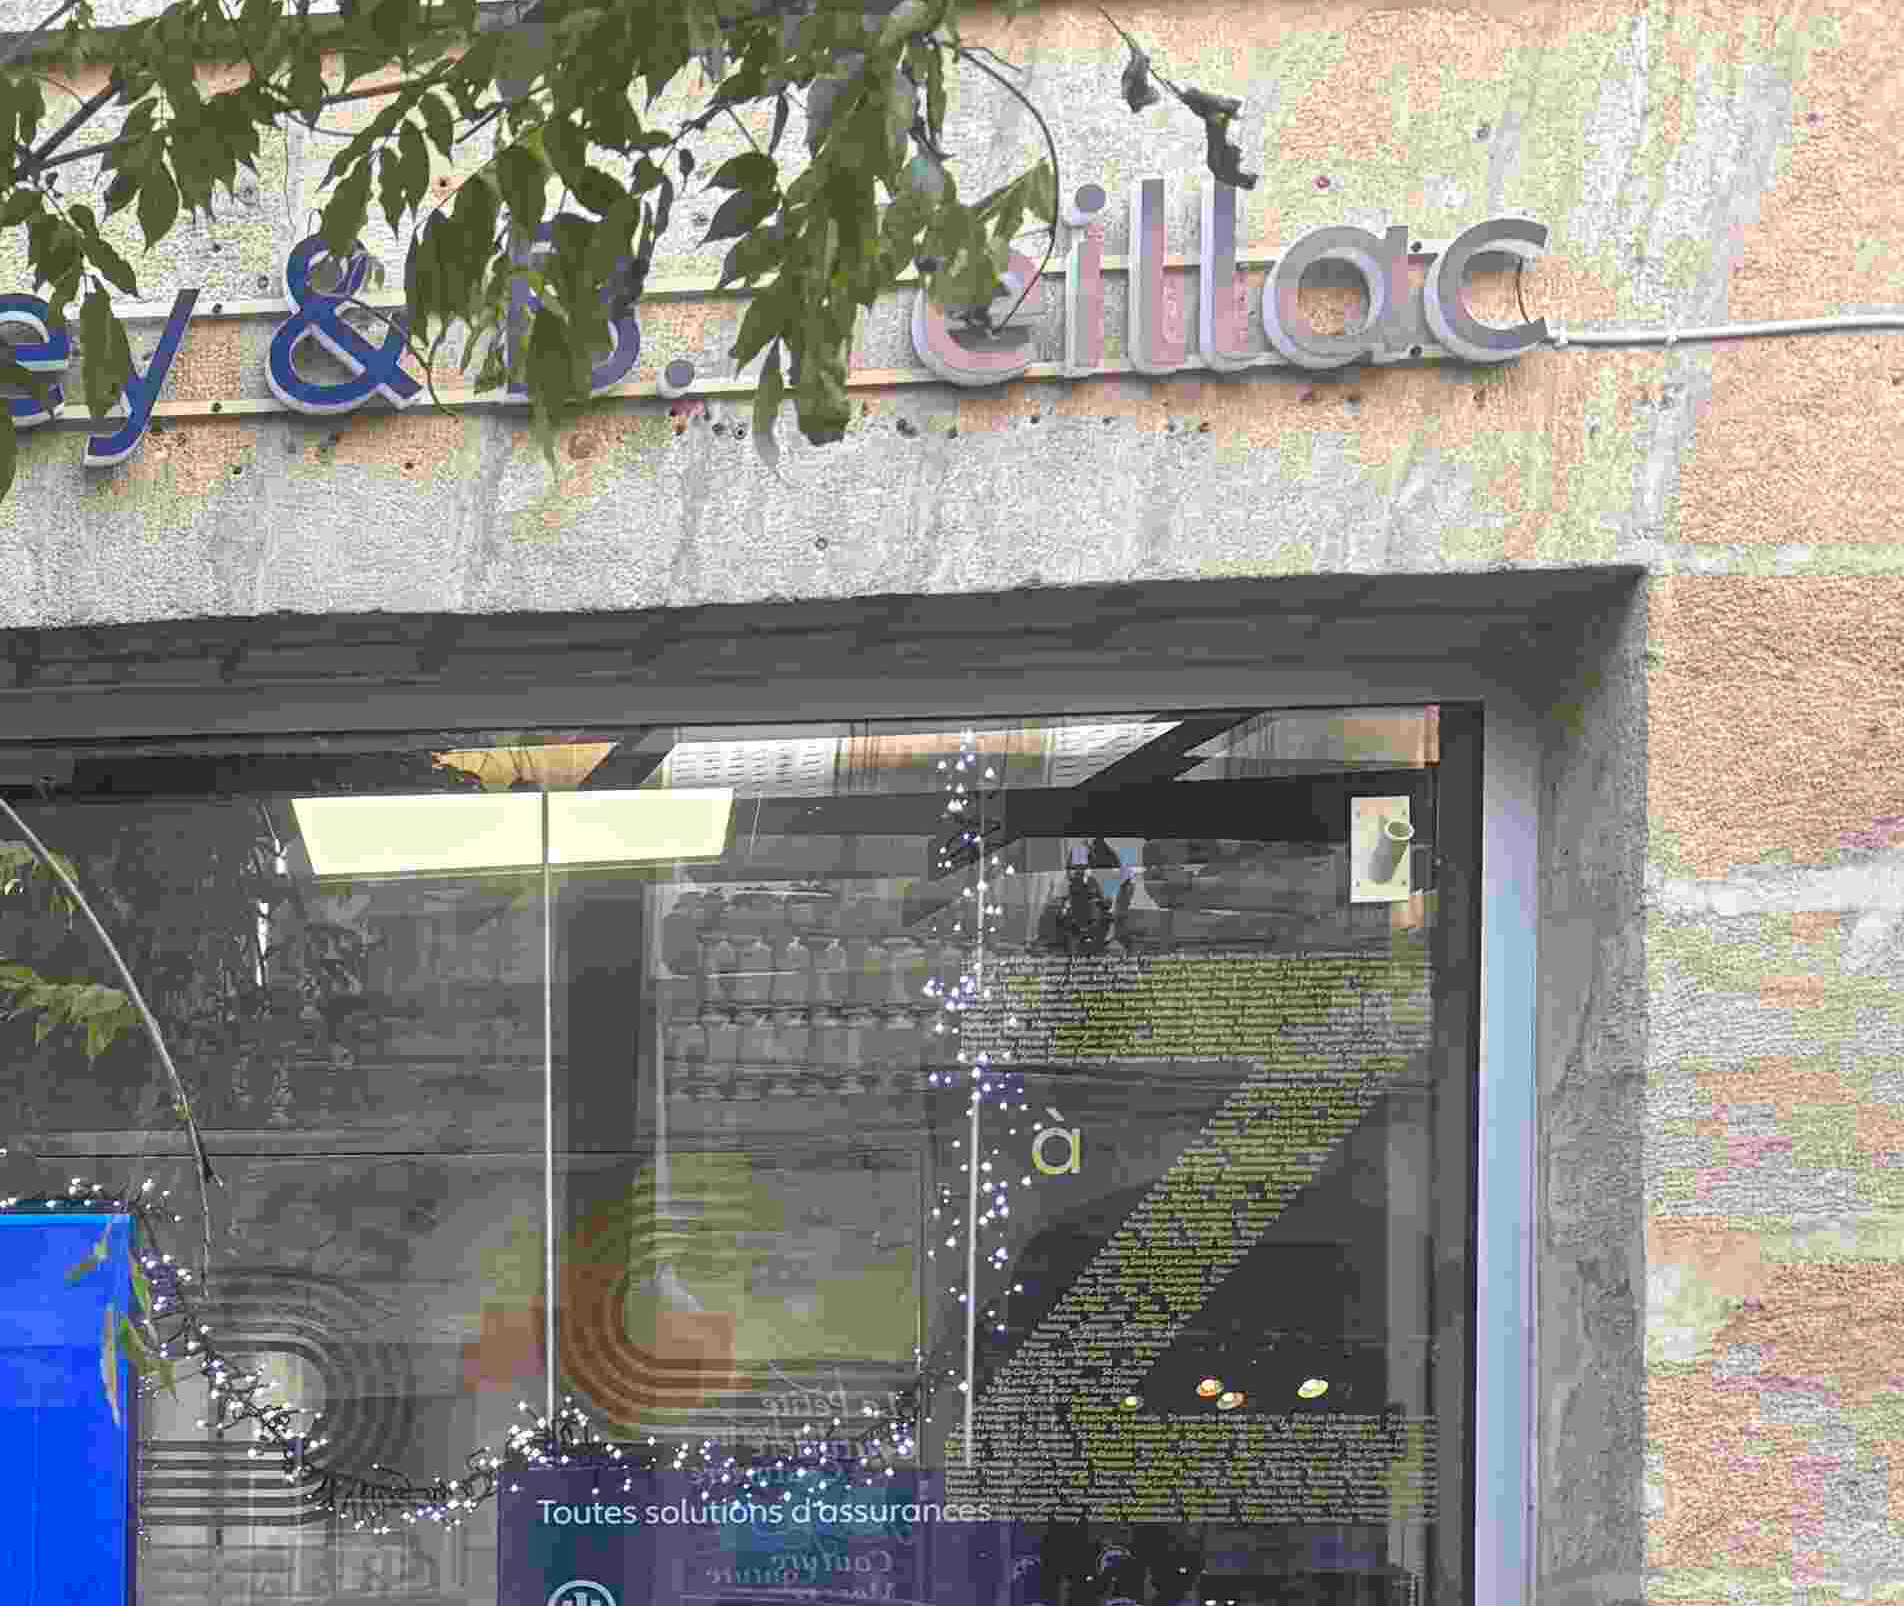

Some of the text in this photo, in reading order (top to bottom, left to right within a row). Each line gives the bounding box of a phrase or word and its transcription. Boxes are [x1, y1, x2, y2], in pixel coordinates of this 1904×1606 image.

[265, 232, 424, 413] &
[910, 178, 1550, 387] eillac
[535, 1498, 640, 1526] Toutes
[645, 1496, 784, 1526] solutions
